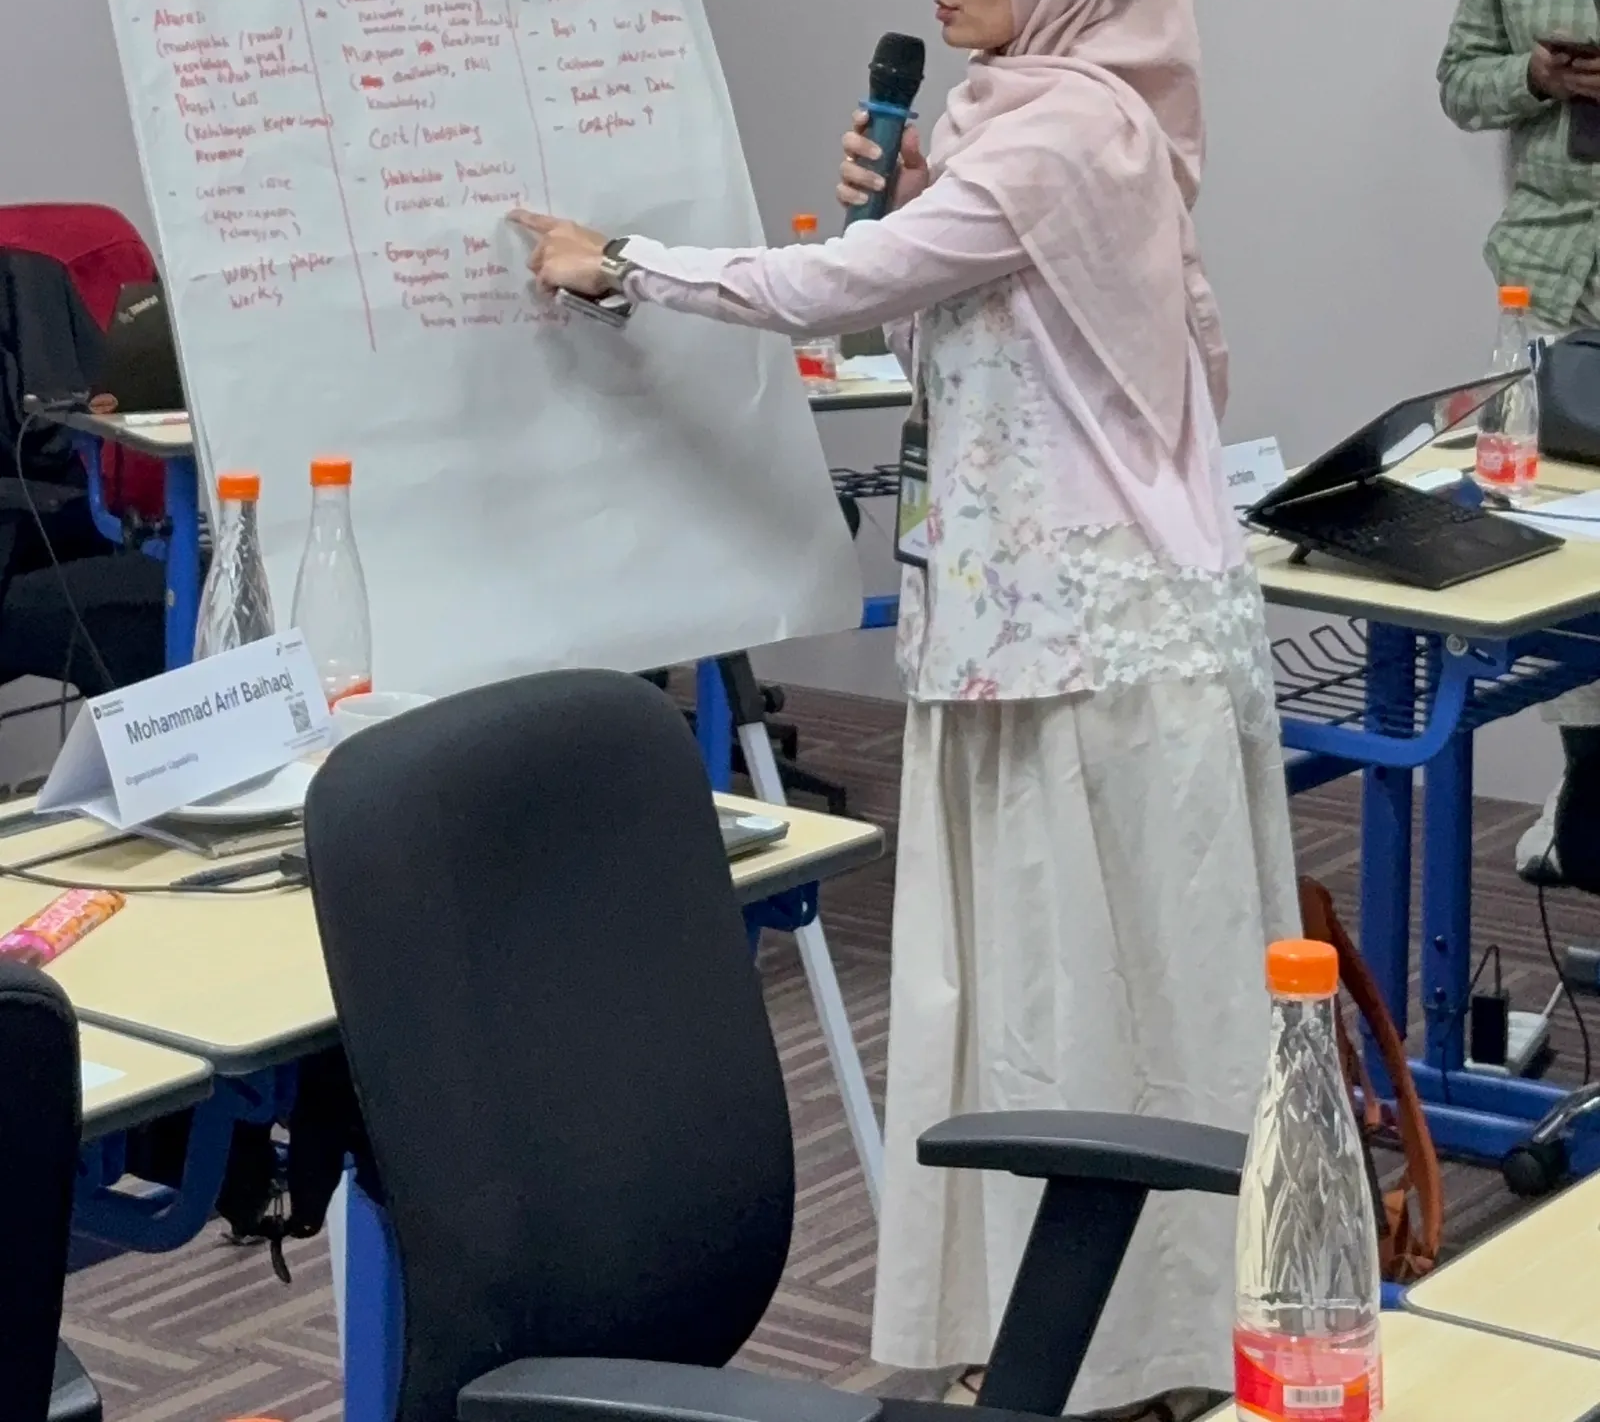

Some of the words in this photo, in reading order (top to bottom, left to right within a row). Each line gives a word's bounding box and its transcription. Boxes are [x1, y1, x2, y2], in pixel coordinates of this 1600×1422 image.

[124, 695, 213, 745] Mohammad
[215, 685, 240, 713] Arif
[240, 666, 294, 703] Baihaqi
